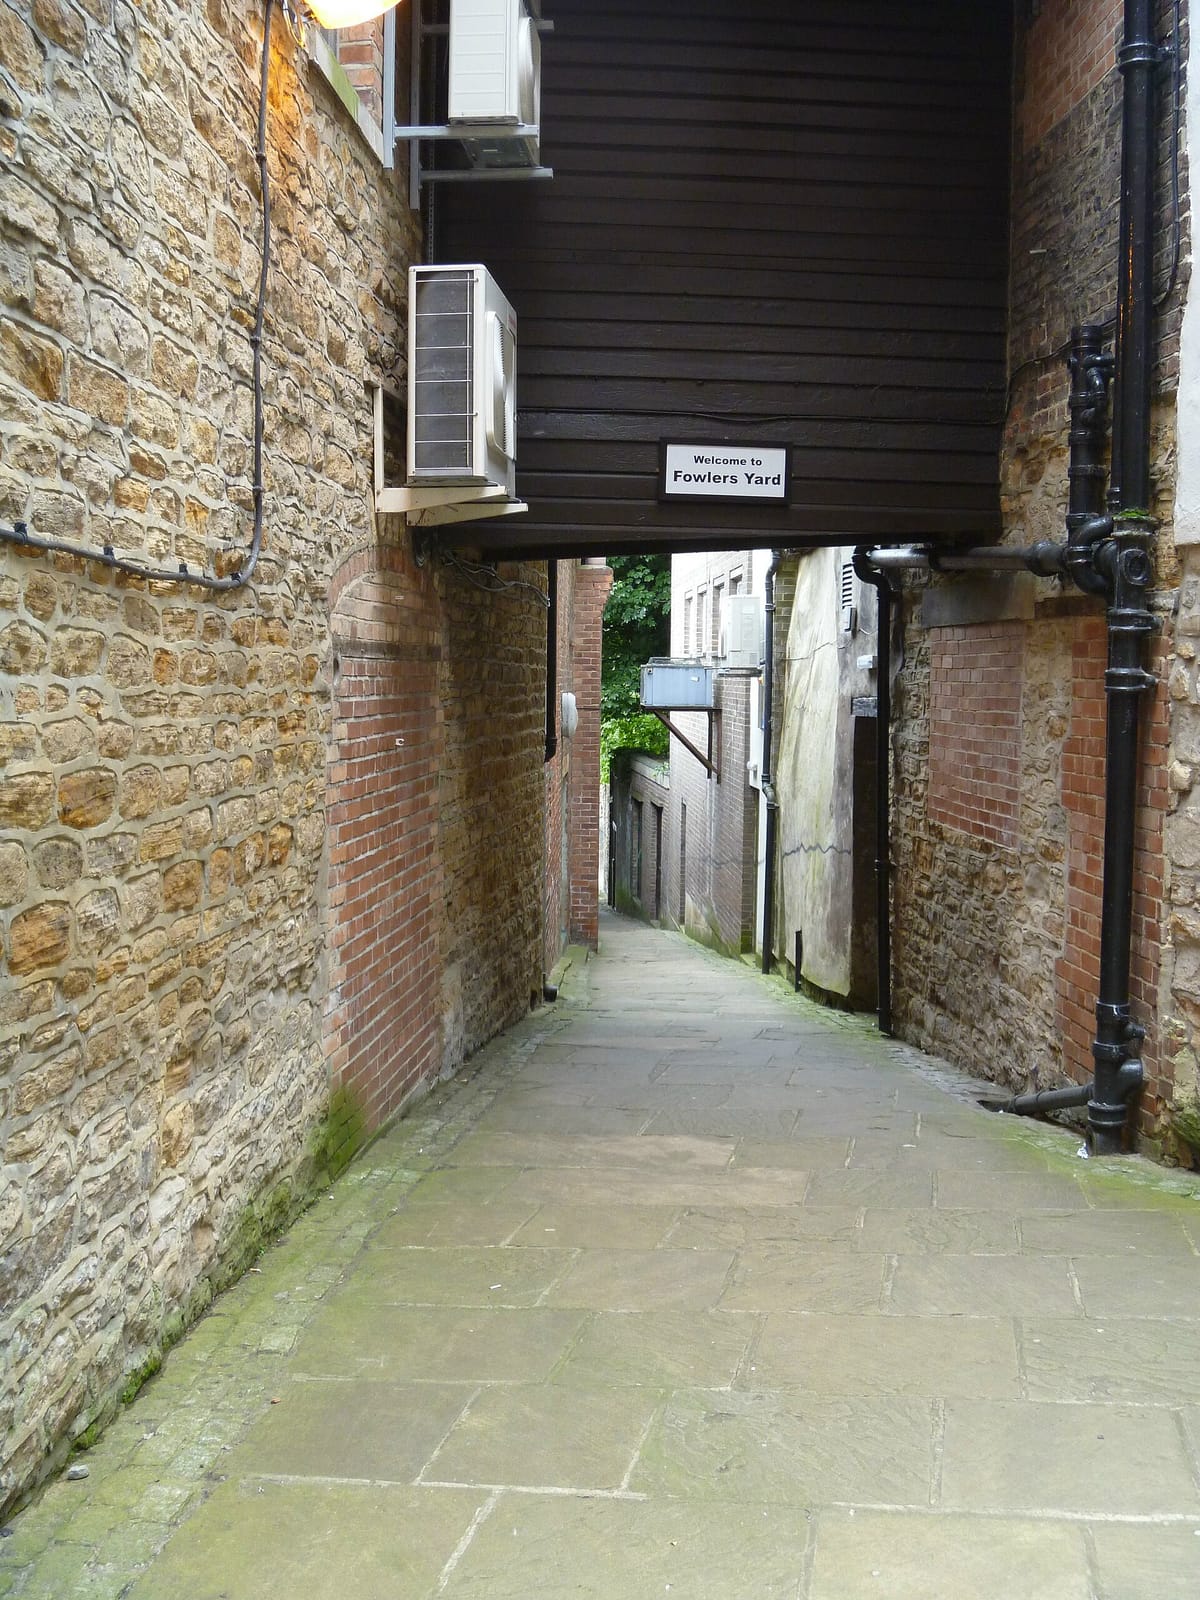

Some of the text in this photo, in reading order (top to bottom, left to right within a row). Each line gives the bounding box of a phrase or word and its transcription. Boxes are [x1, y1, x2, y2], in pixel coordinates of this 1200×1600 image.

[694, 455, 762, 466] Welcome to
[673, 470, 781, 485] Fowlers Yard
